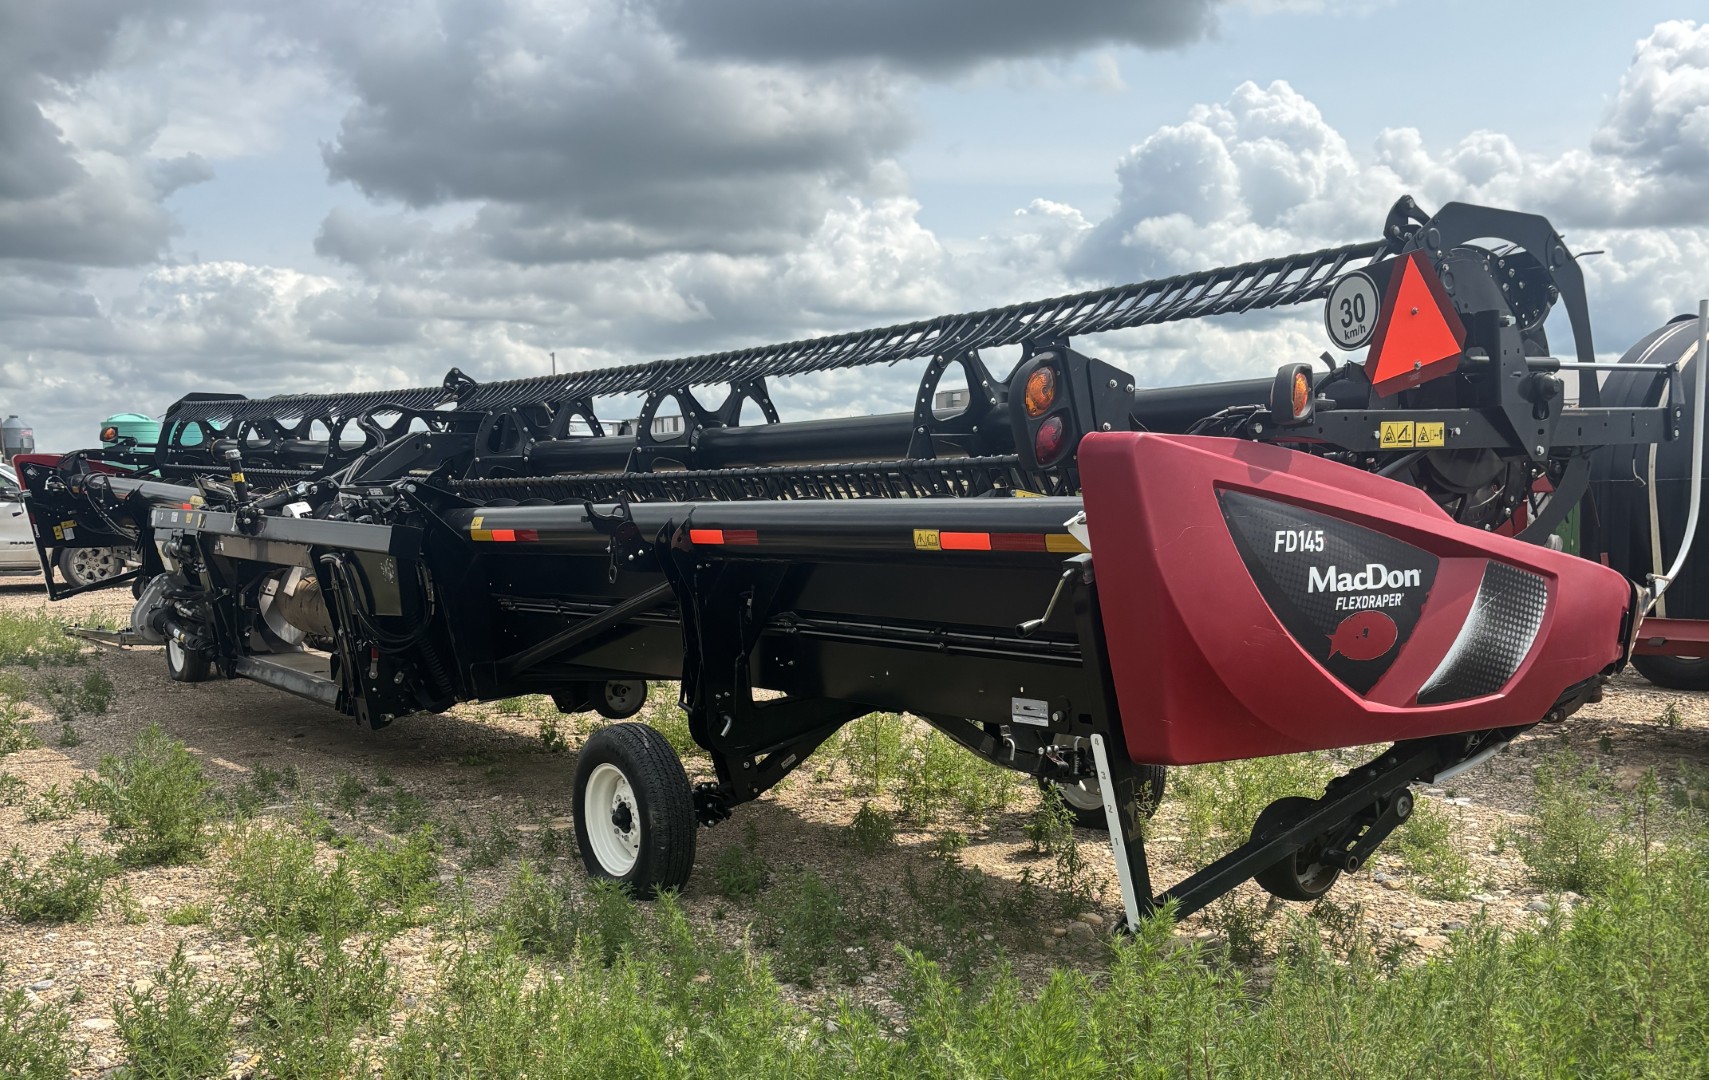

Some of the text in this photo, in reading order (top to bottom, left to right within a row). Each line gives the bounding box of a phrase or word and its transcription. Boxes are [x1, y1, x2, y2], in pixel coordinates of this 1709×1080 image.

[1340, 293, 1366, 328] 30
[1344, 324, 1366, 340] km/h
[1274, 530, 1324, 553] FD145
[1307, 563, 1421, 593] MacDon
[1335, 593, 1404, 611] FLEXDRAPER
[1101, 771, 1106, 780] 3
[1107, 804, 1113, 813] 2
